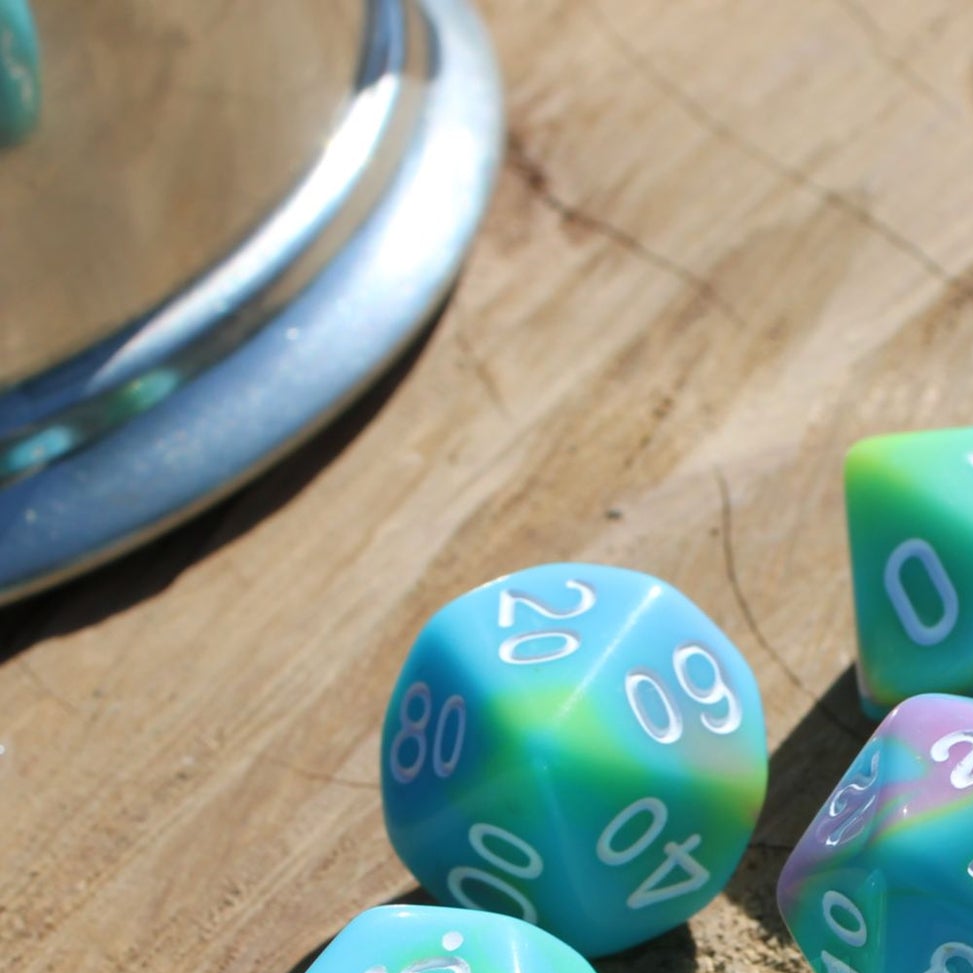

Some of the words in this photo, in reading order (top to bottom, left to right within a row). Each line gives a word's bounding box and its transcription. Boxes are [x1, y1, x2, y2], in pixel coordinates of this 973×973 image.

[498, 579, 597, 665] 20
[884, 537, 958, 645] 0
[389, 681, 466, 784] 80
[595, 796, 711, 910] 40
